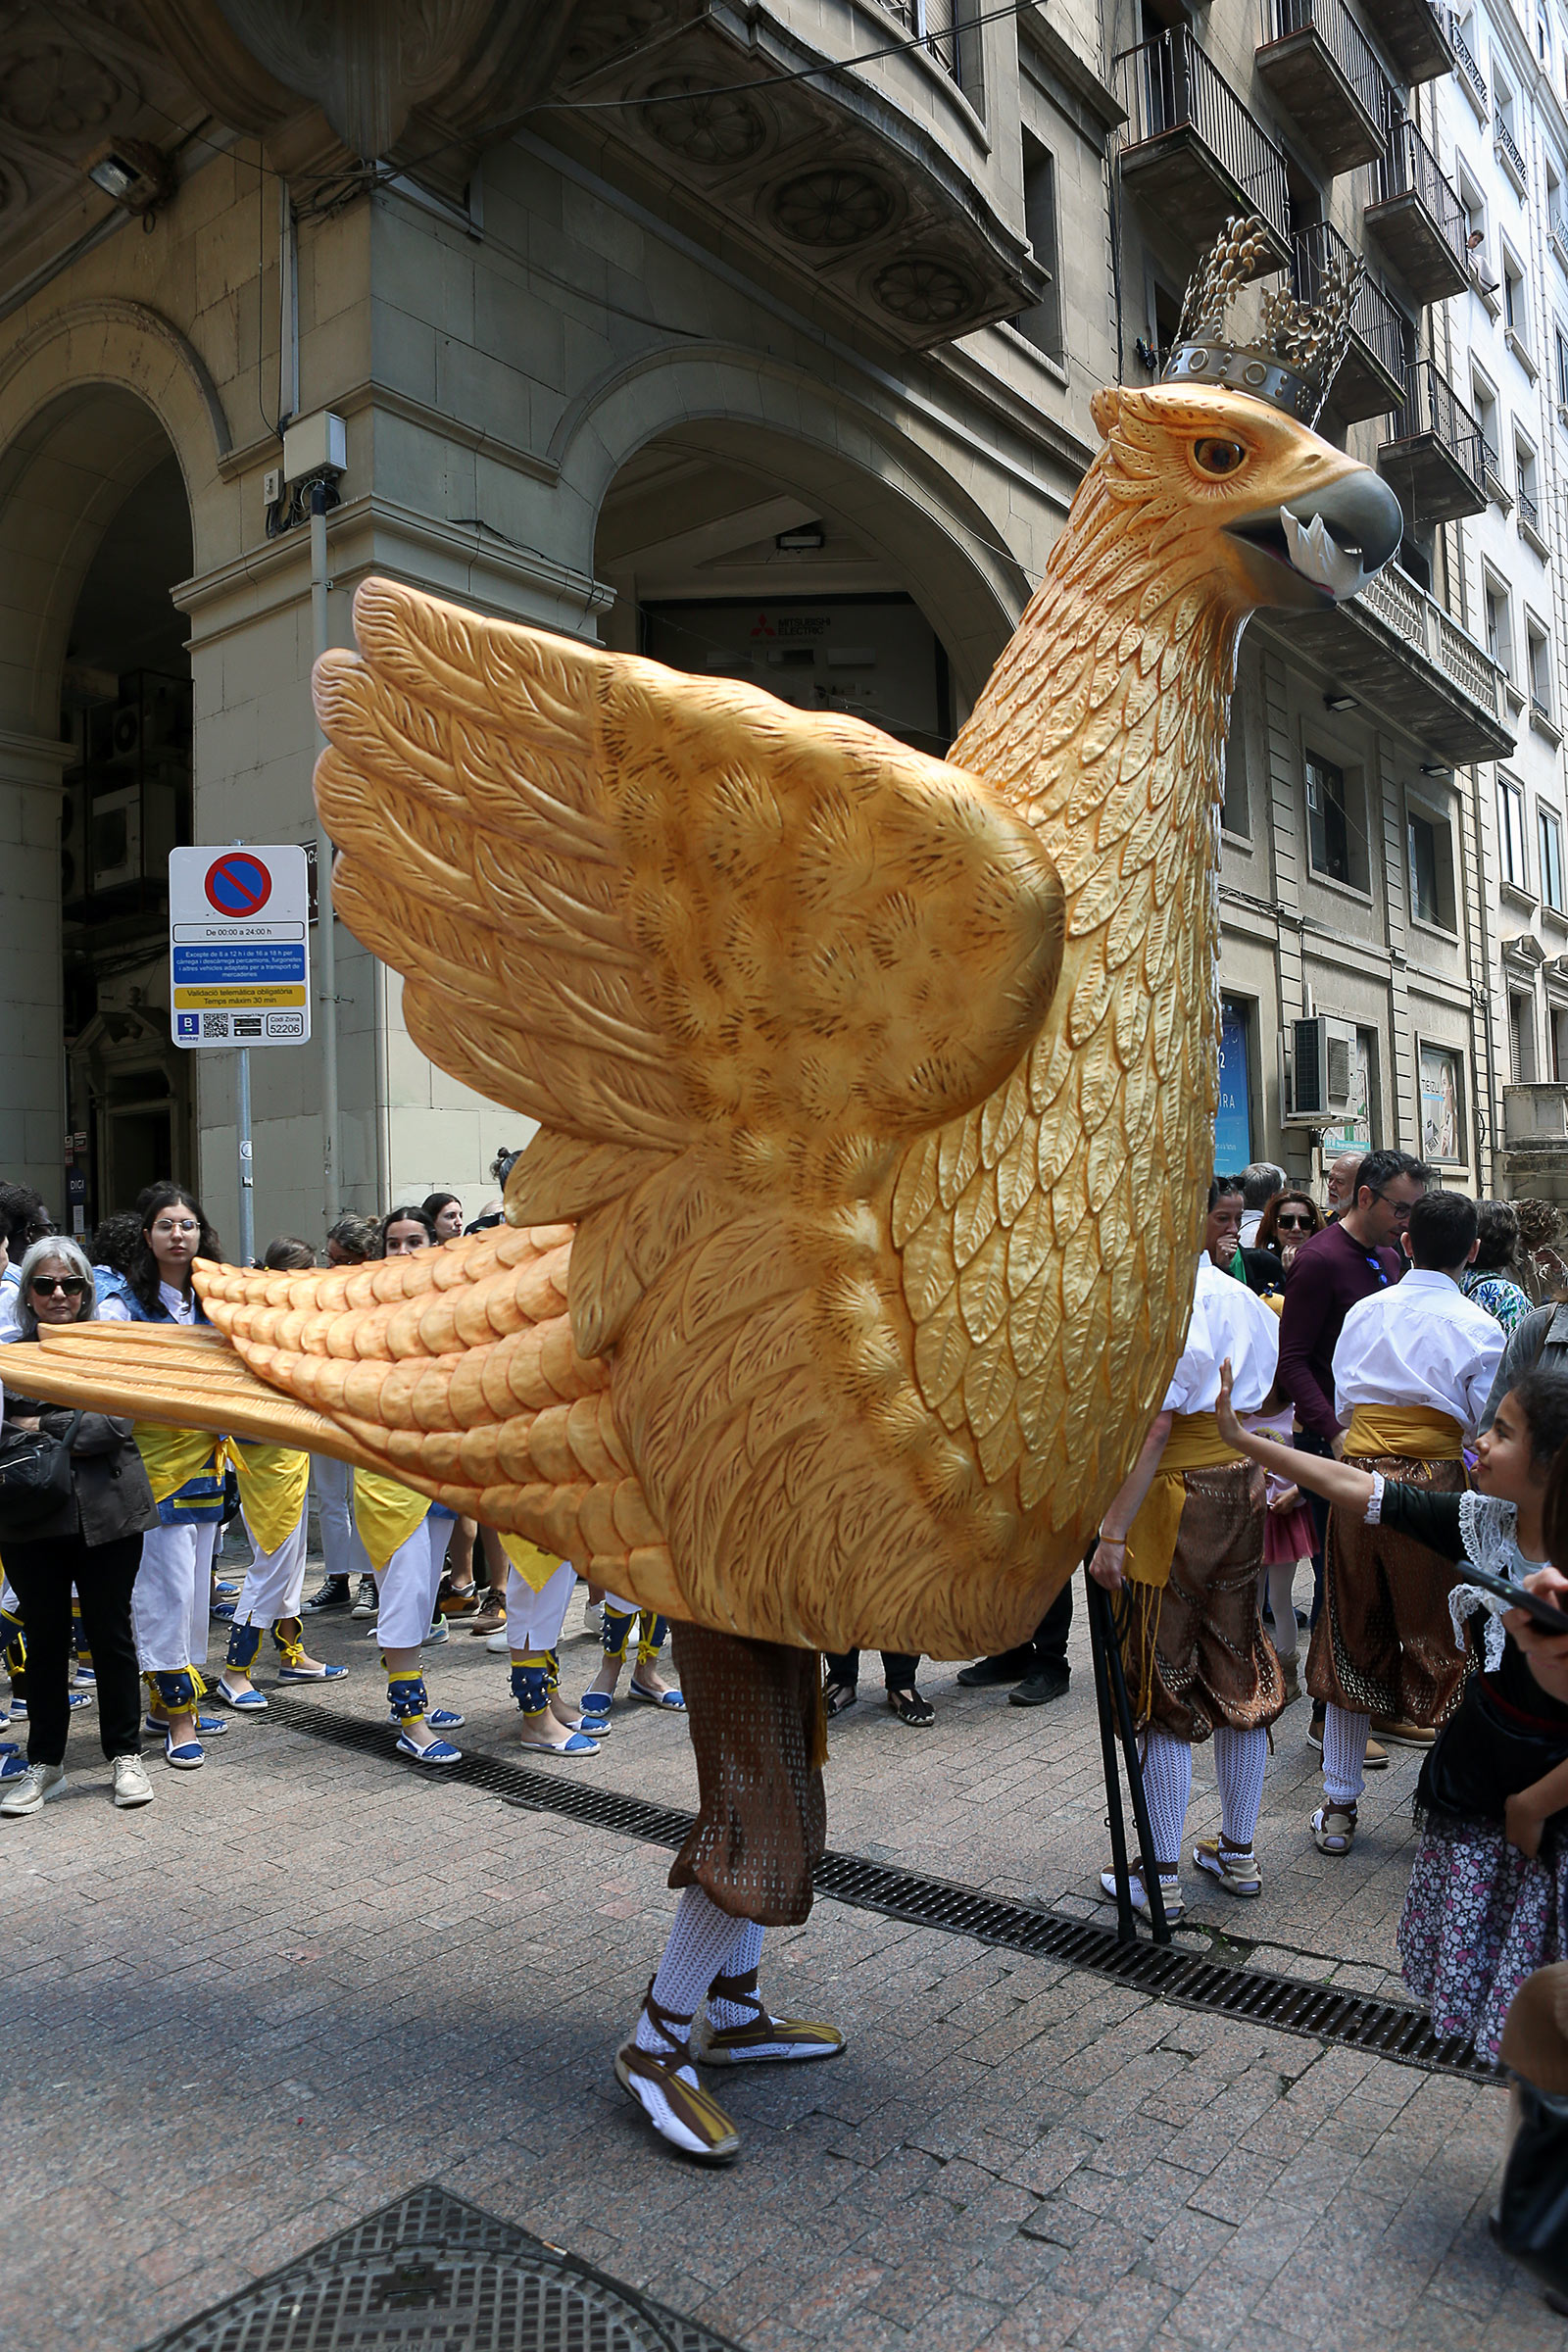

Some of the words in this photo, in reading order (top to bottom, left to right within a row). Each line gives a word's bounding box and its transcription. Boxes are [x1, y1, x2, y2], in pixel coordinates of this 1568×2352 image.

[777, 616, 831, 627] MITSUBISHI
[777, 626, 824, 636] ELECTRIC
[204, 997, 227, 1005] Temps
[183, 1017, 193, 1028] B
[270, 1024, 300, 1034] 52206
[70, 1179, 85, 1191] DIGI
